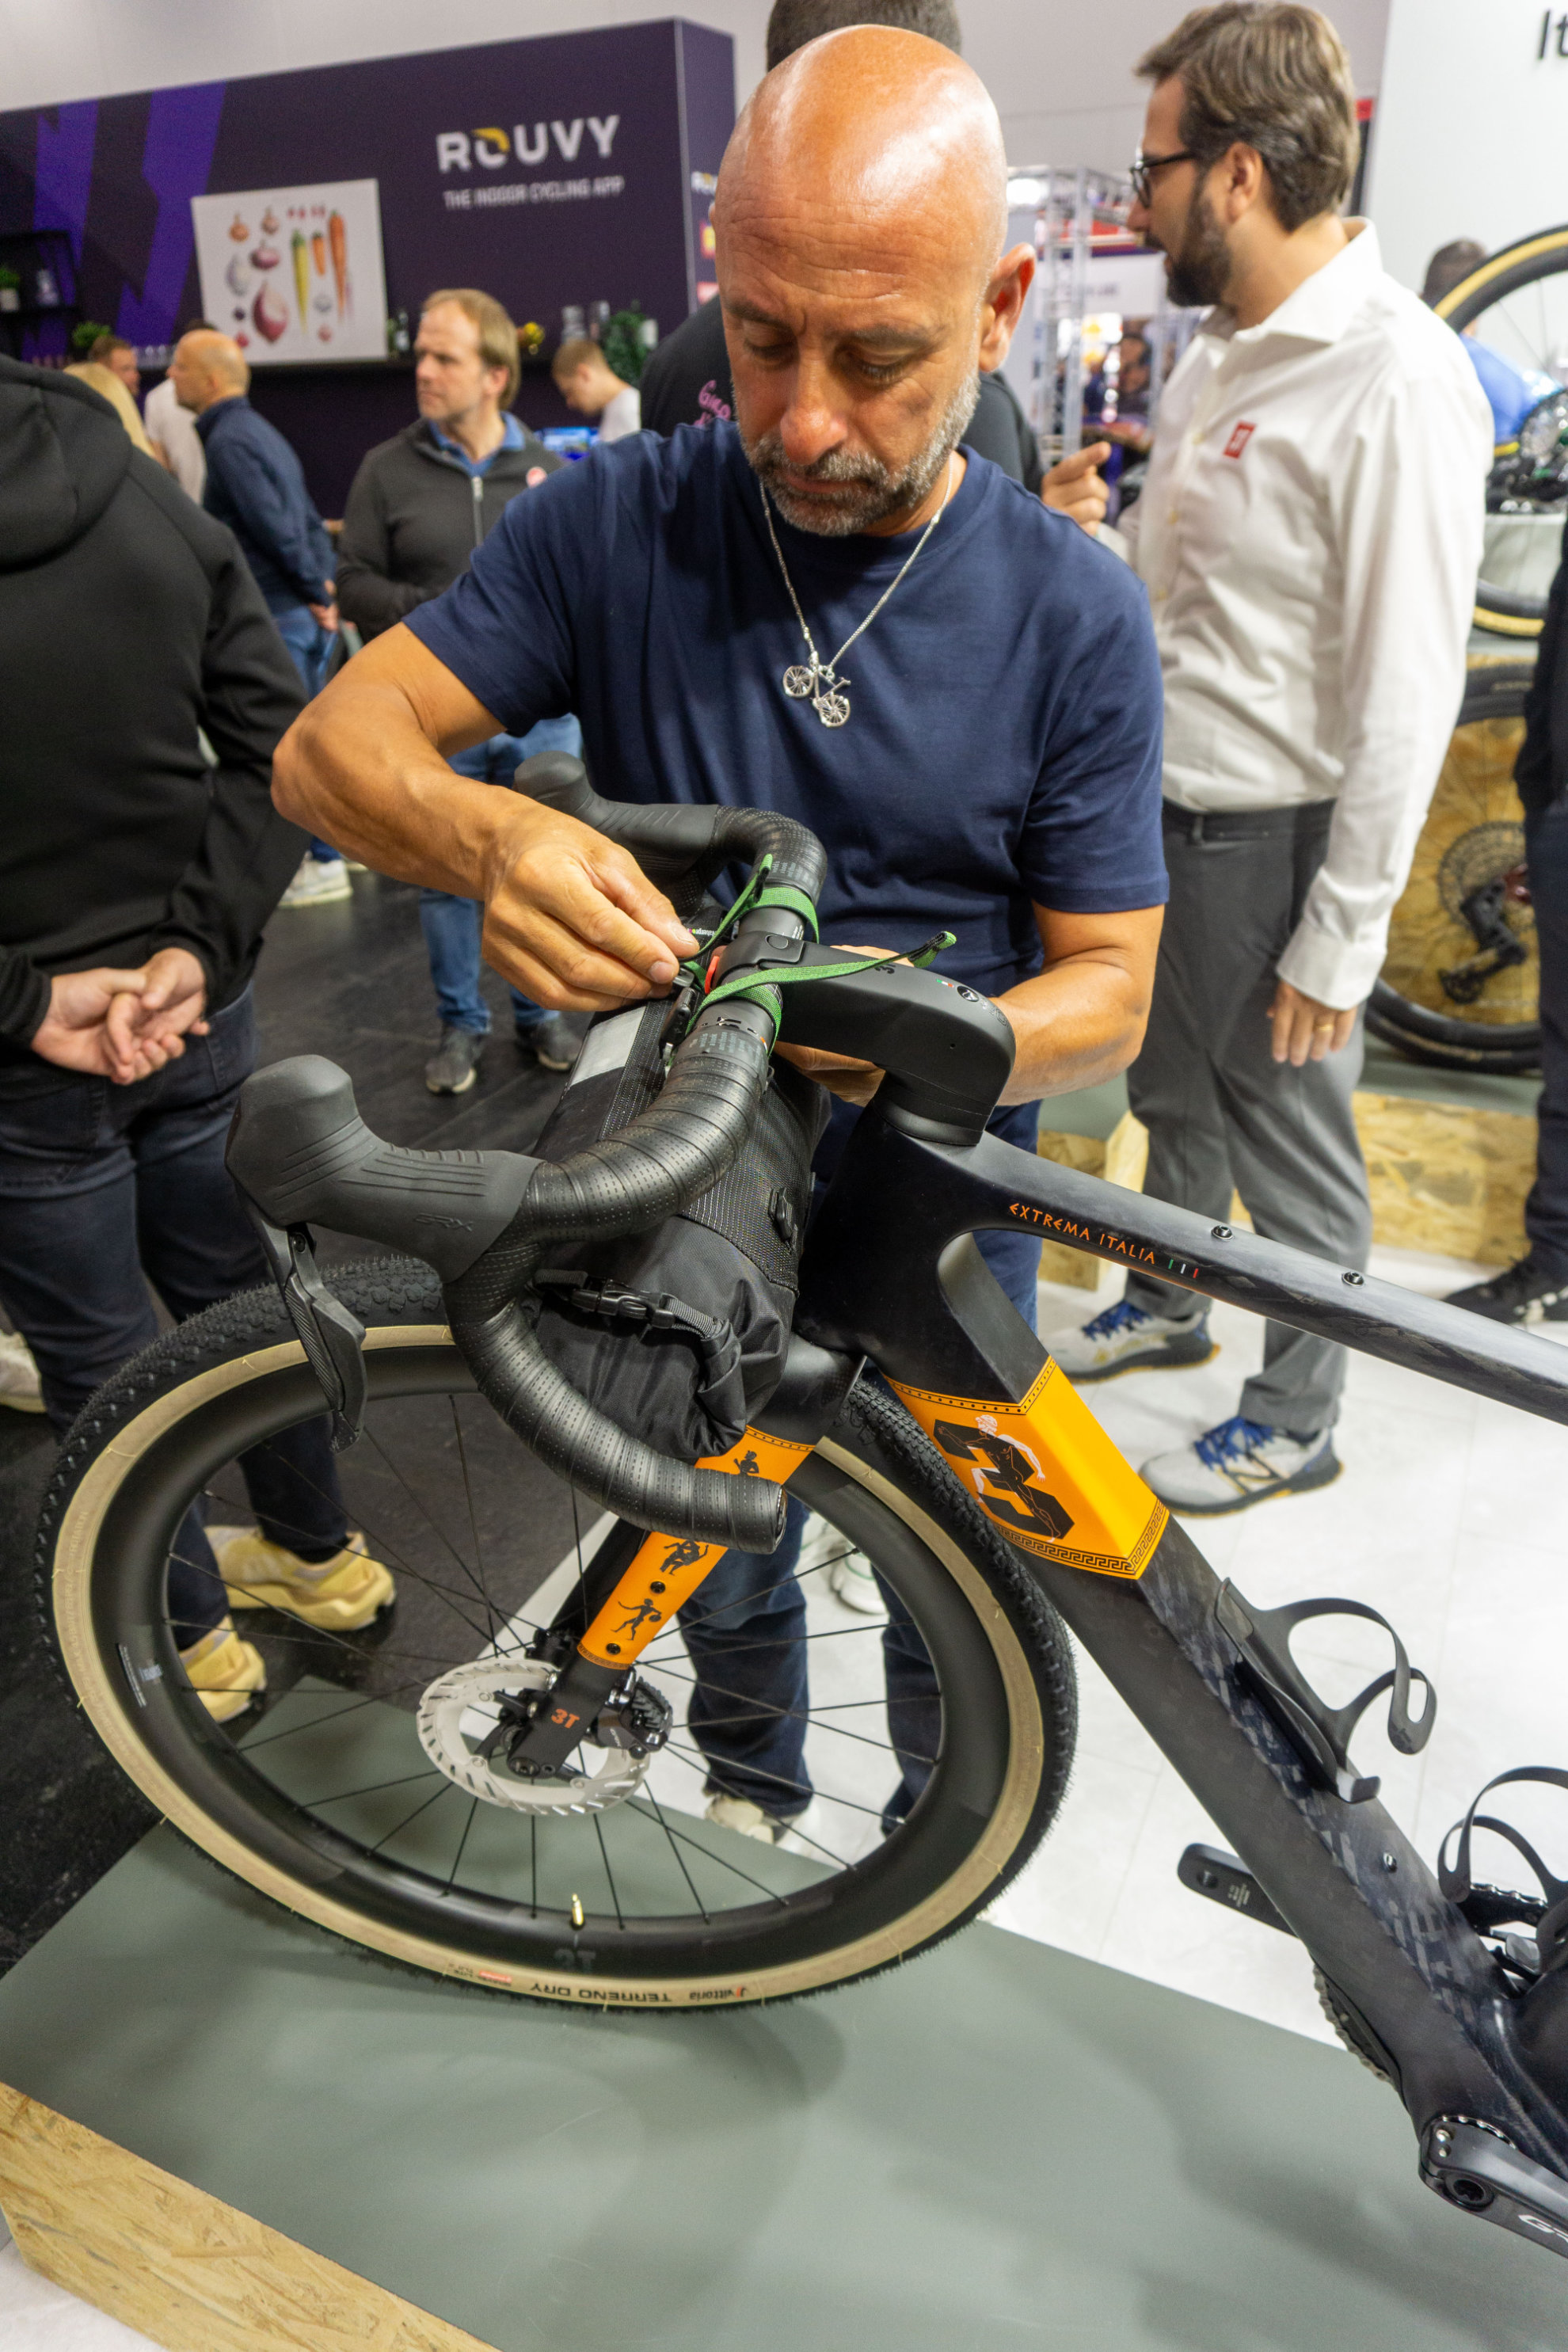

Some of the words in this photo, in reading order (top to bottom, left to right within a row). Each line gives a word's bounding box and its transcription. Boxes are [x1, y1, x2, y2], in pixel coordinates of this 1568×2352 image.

[436, 115, 620, 173] ROUVY
[443, 188, 471, 211] THE
[529, 177, 591, 204] CYCLING
[592, 174, 626, 197] APP
[1009, 1202, 1090, 1241] EXTREMA
[1099, 1233, 1155, 1265] ITALIA
[550, 1708, 580, 1729] 3T
[530, 1982, 571, 1996] DRY
[579, 1989, 672, 2003] TERRENO
